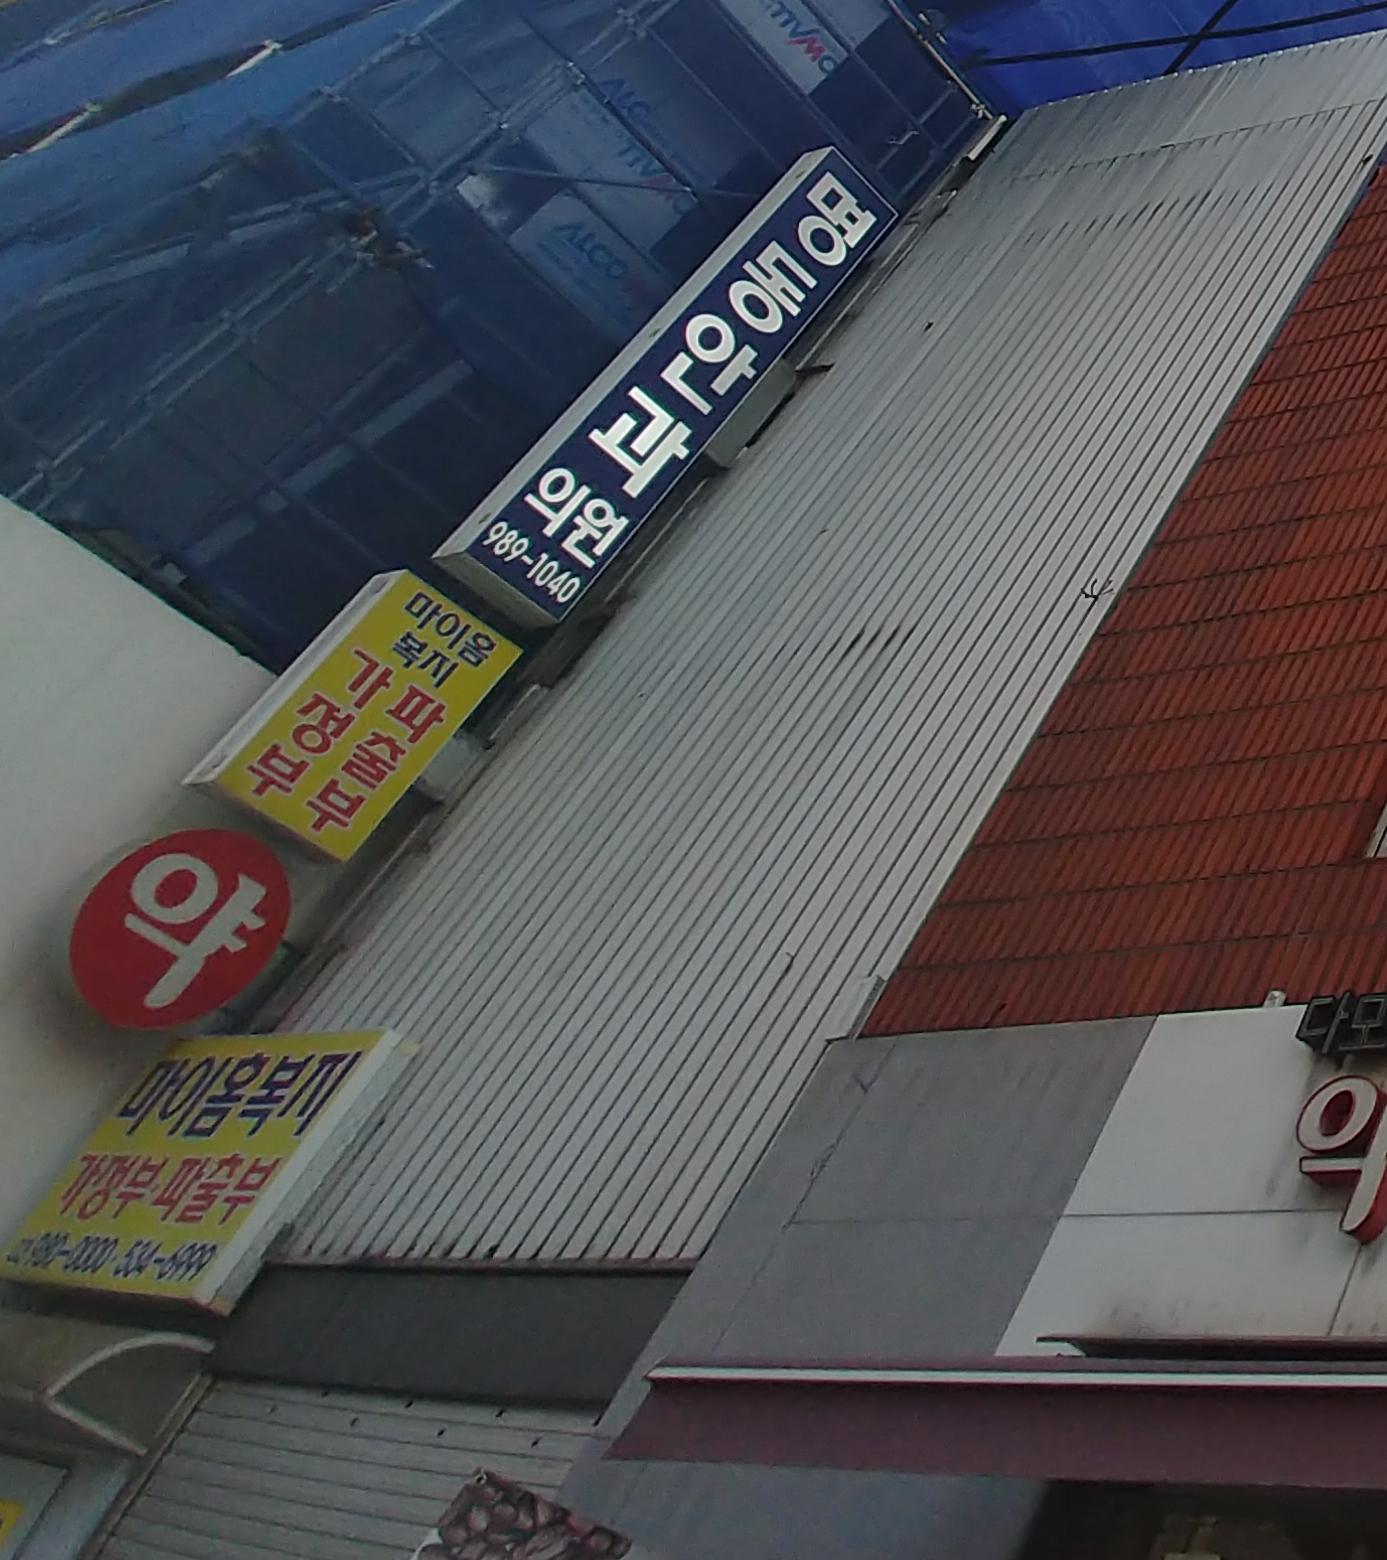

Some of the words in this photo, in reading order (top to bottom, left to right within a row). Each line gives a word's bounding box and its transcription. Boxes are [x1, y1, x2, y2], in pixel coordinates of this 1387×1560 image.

[589, 172, 877, 497] 명동안과
[484, 520, 581, 605] 989-1040
[524, 469, 628, 566] 의원
[247, 649, 390, 798] 가정부
[392, 632, 459, 688] 복지
[307, 685, 448, 832] 파출부
[124, 852, 267, 1009] 약
